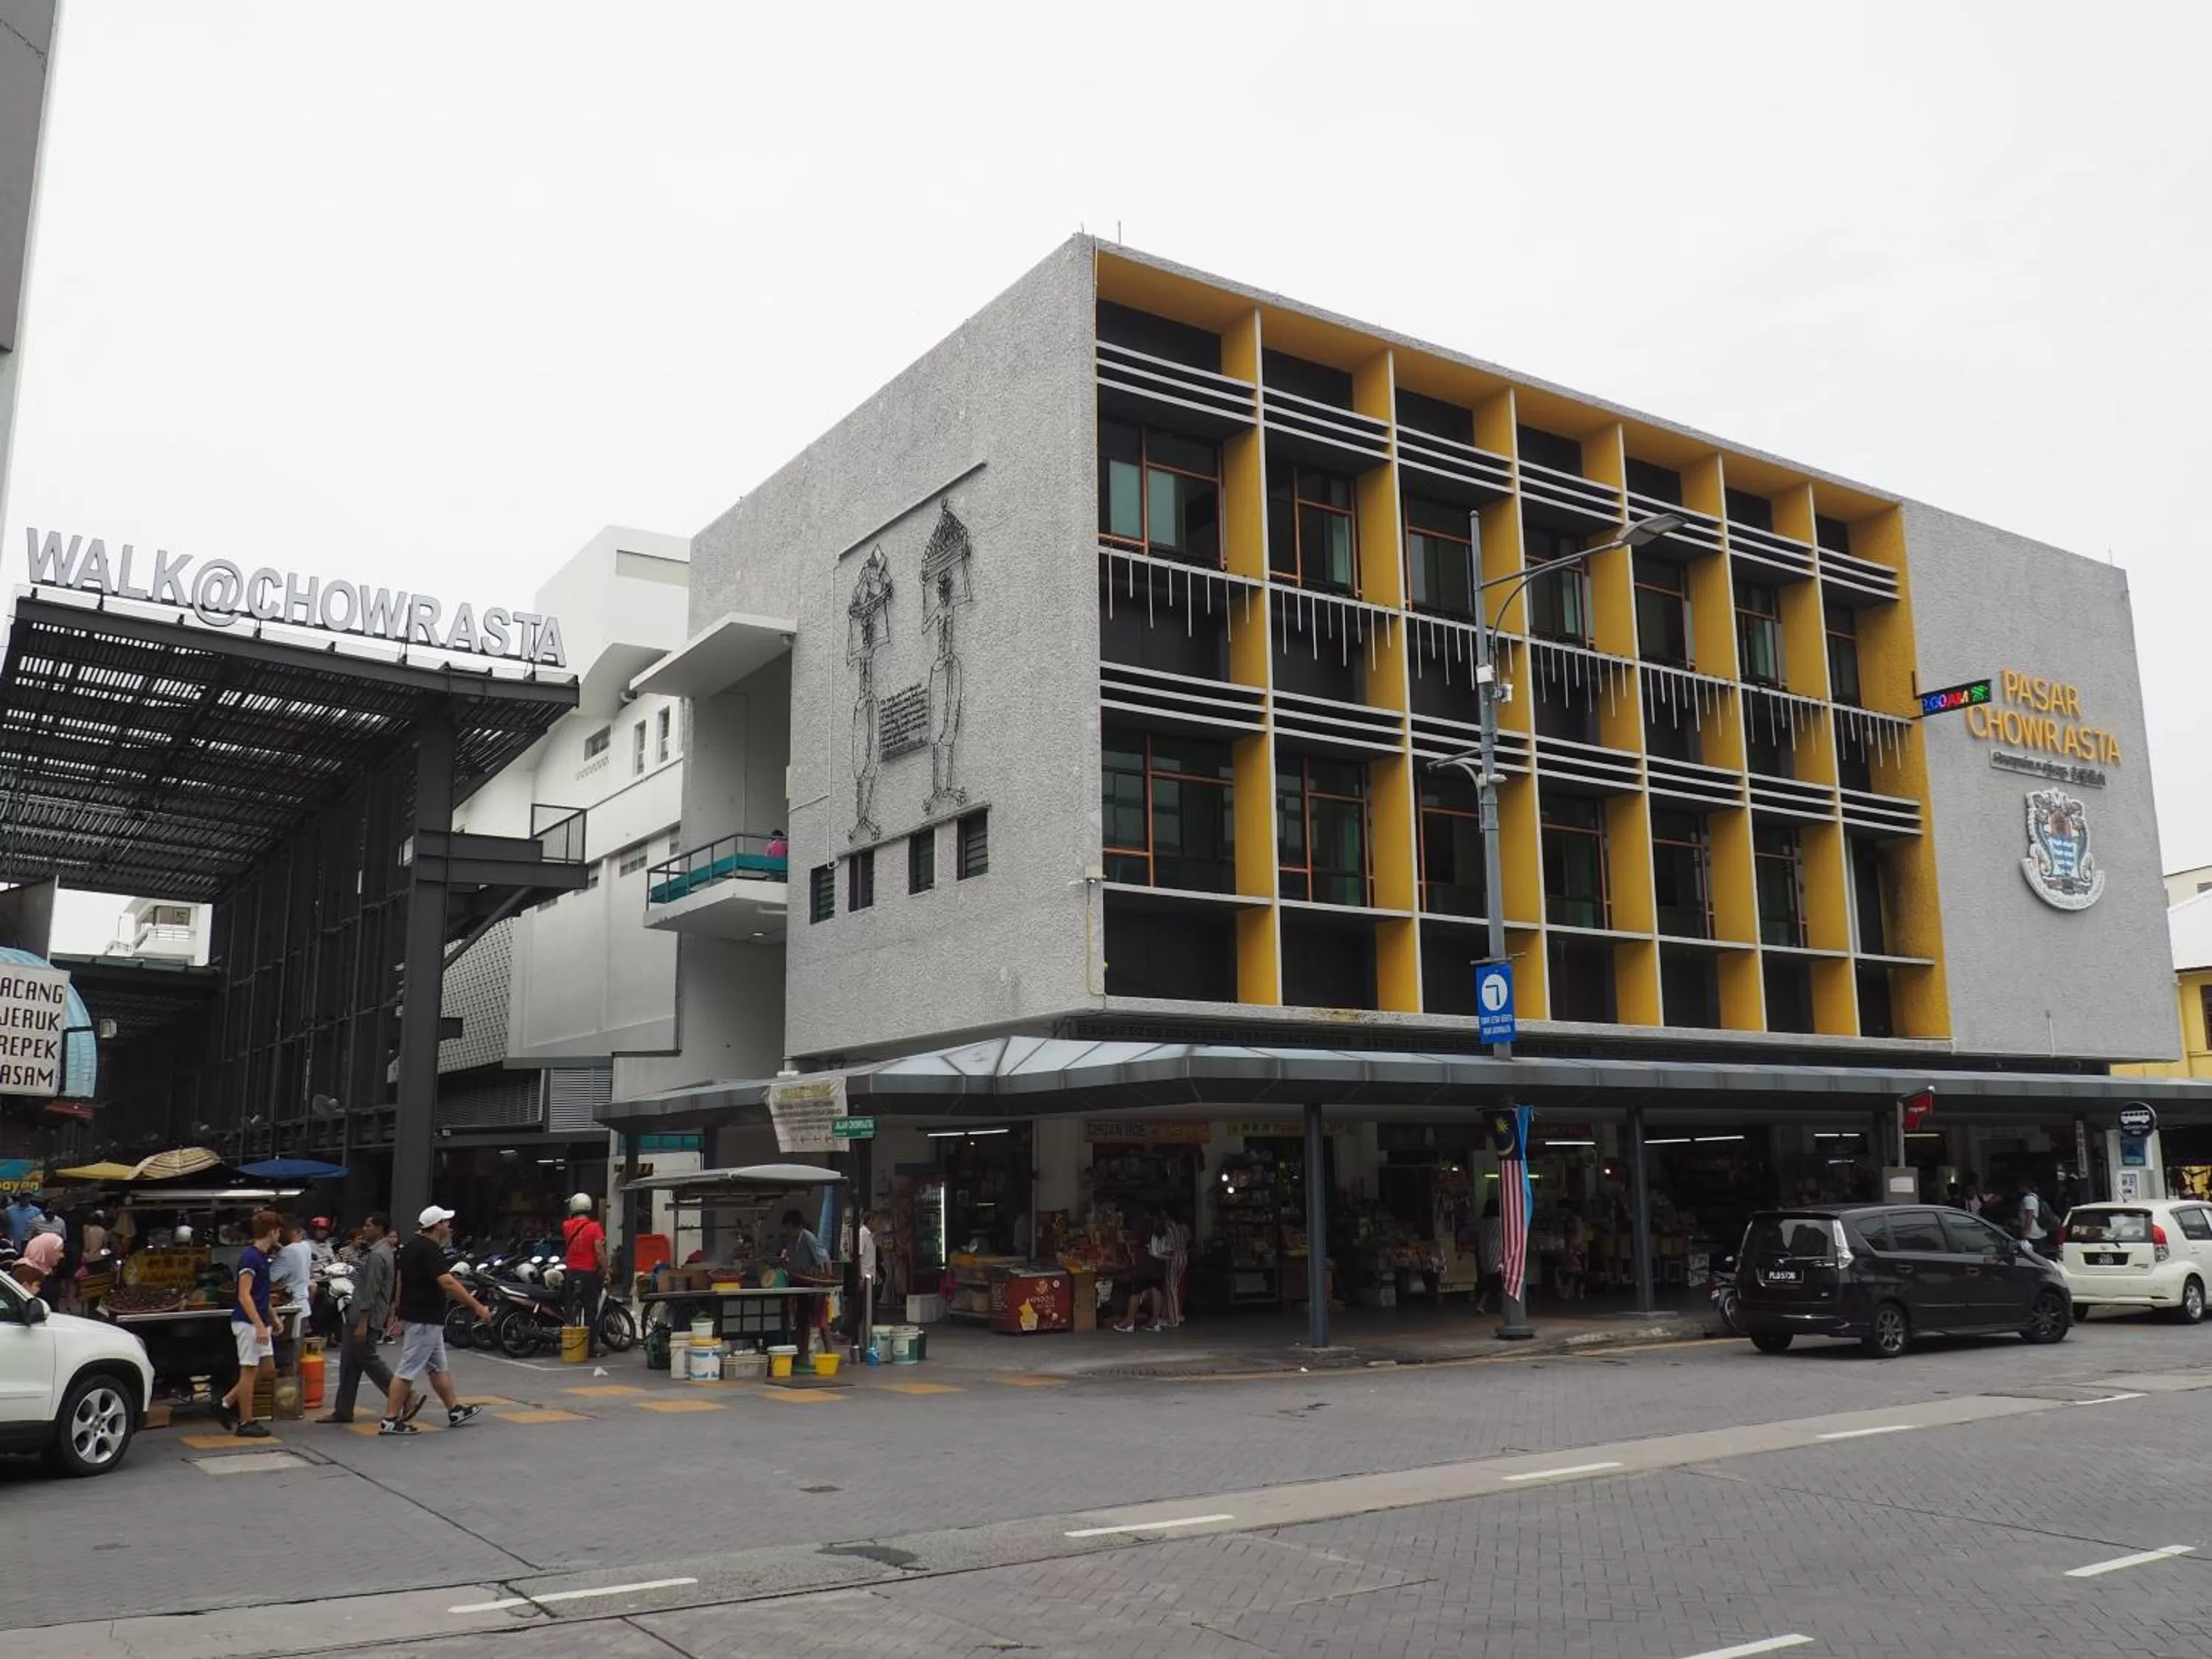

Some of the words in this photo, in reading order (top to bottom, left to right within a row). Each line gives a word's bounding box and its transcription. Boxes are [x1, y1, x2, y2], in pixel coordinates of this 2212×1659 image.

[27, 526, 566, 667] WALK@CHOWRASTA
[2001, 668, 2082, 717] PASAR
[1965, 704, 2121, 764] CHOWRASTA
[0, 977, 64, 1004] ACANG
[0, 1006, 60, 1031] JERUK
[0, 1064, 54, 1087] ASAM
